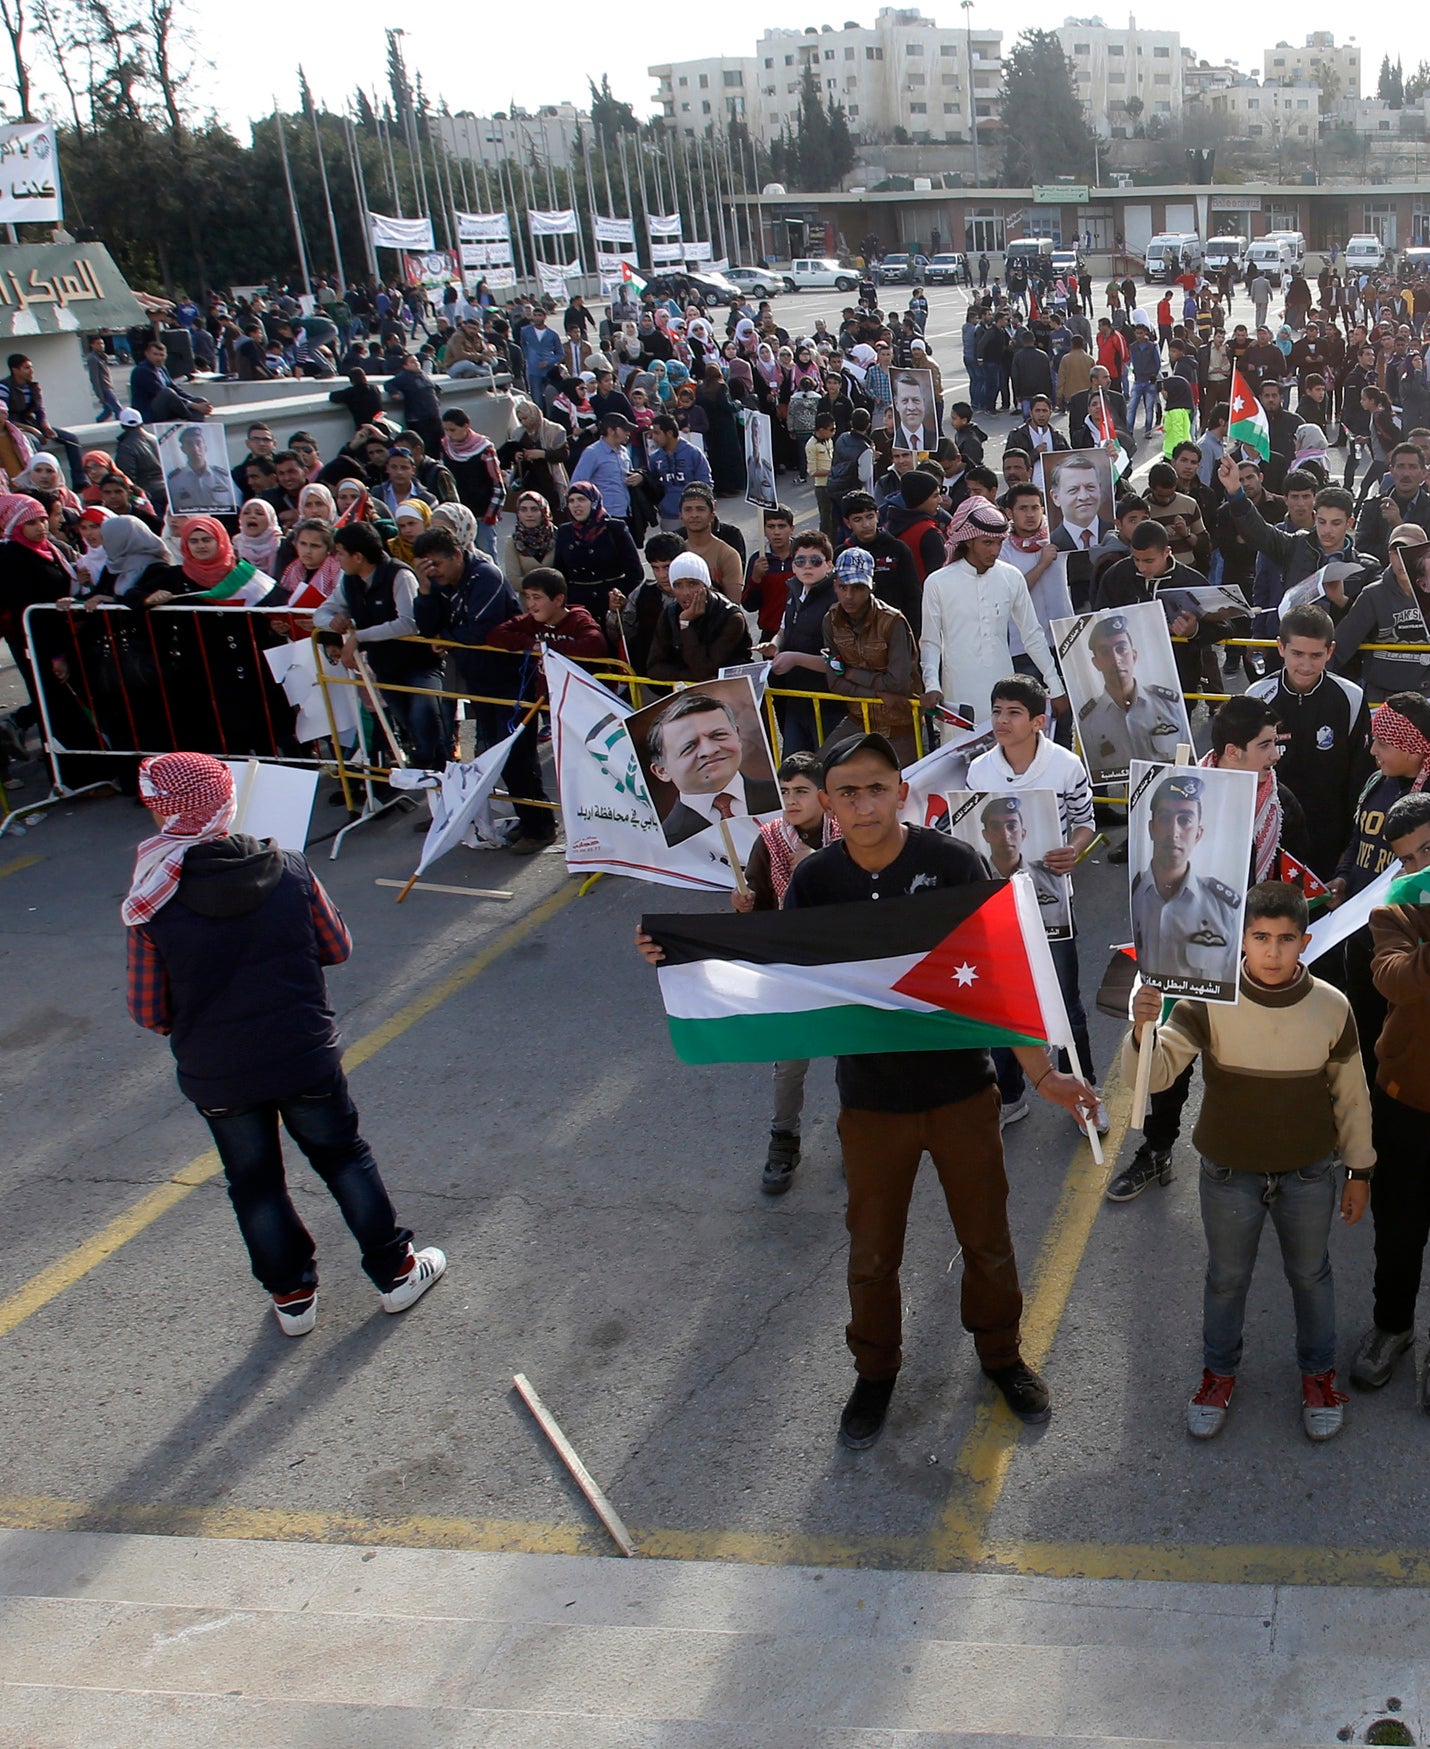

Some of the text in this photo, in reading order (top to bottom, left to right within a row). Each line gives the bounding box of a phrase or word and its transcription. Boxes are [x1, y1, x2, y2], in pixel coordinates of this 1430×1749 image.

[7, 259, 105, 310] المركز
[594, 804, 629, 822] محافظة
[1163, 979, 1188, 992] البطل
[1189, 982, 1220, 995] الشهيد
